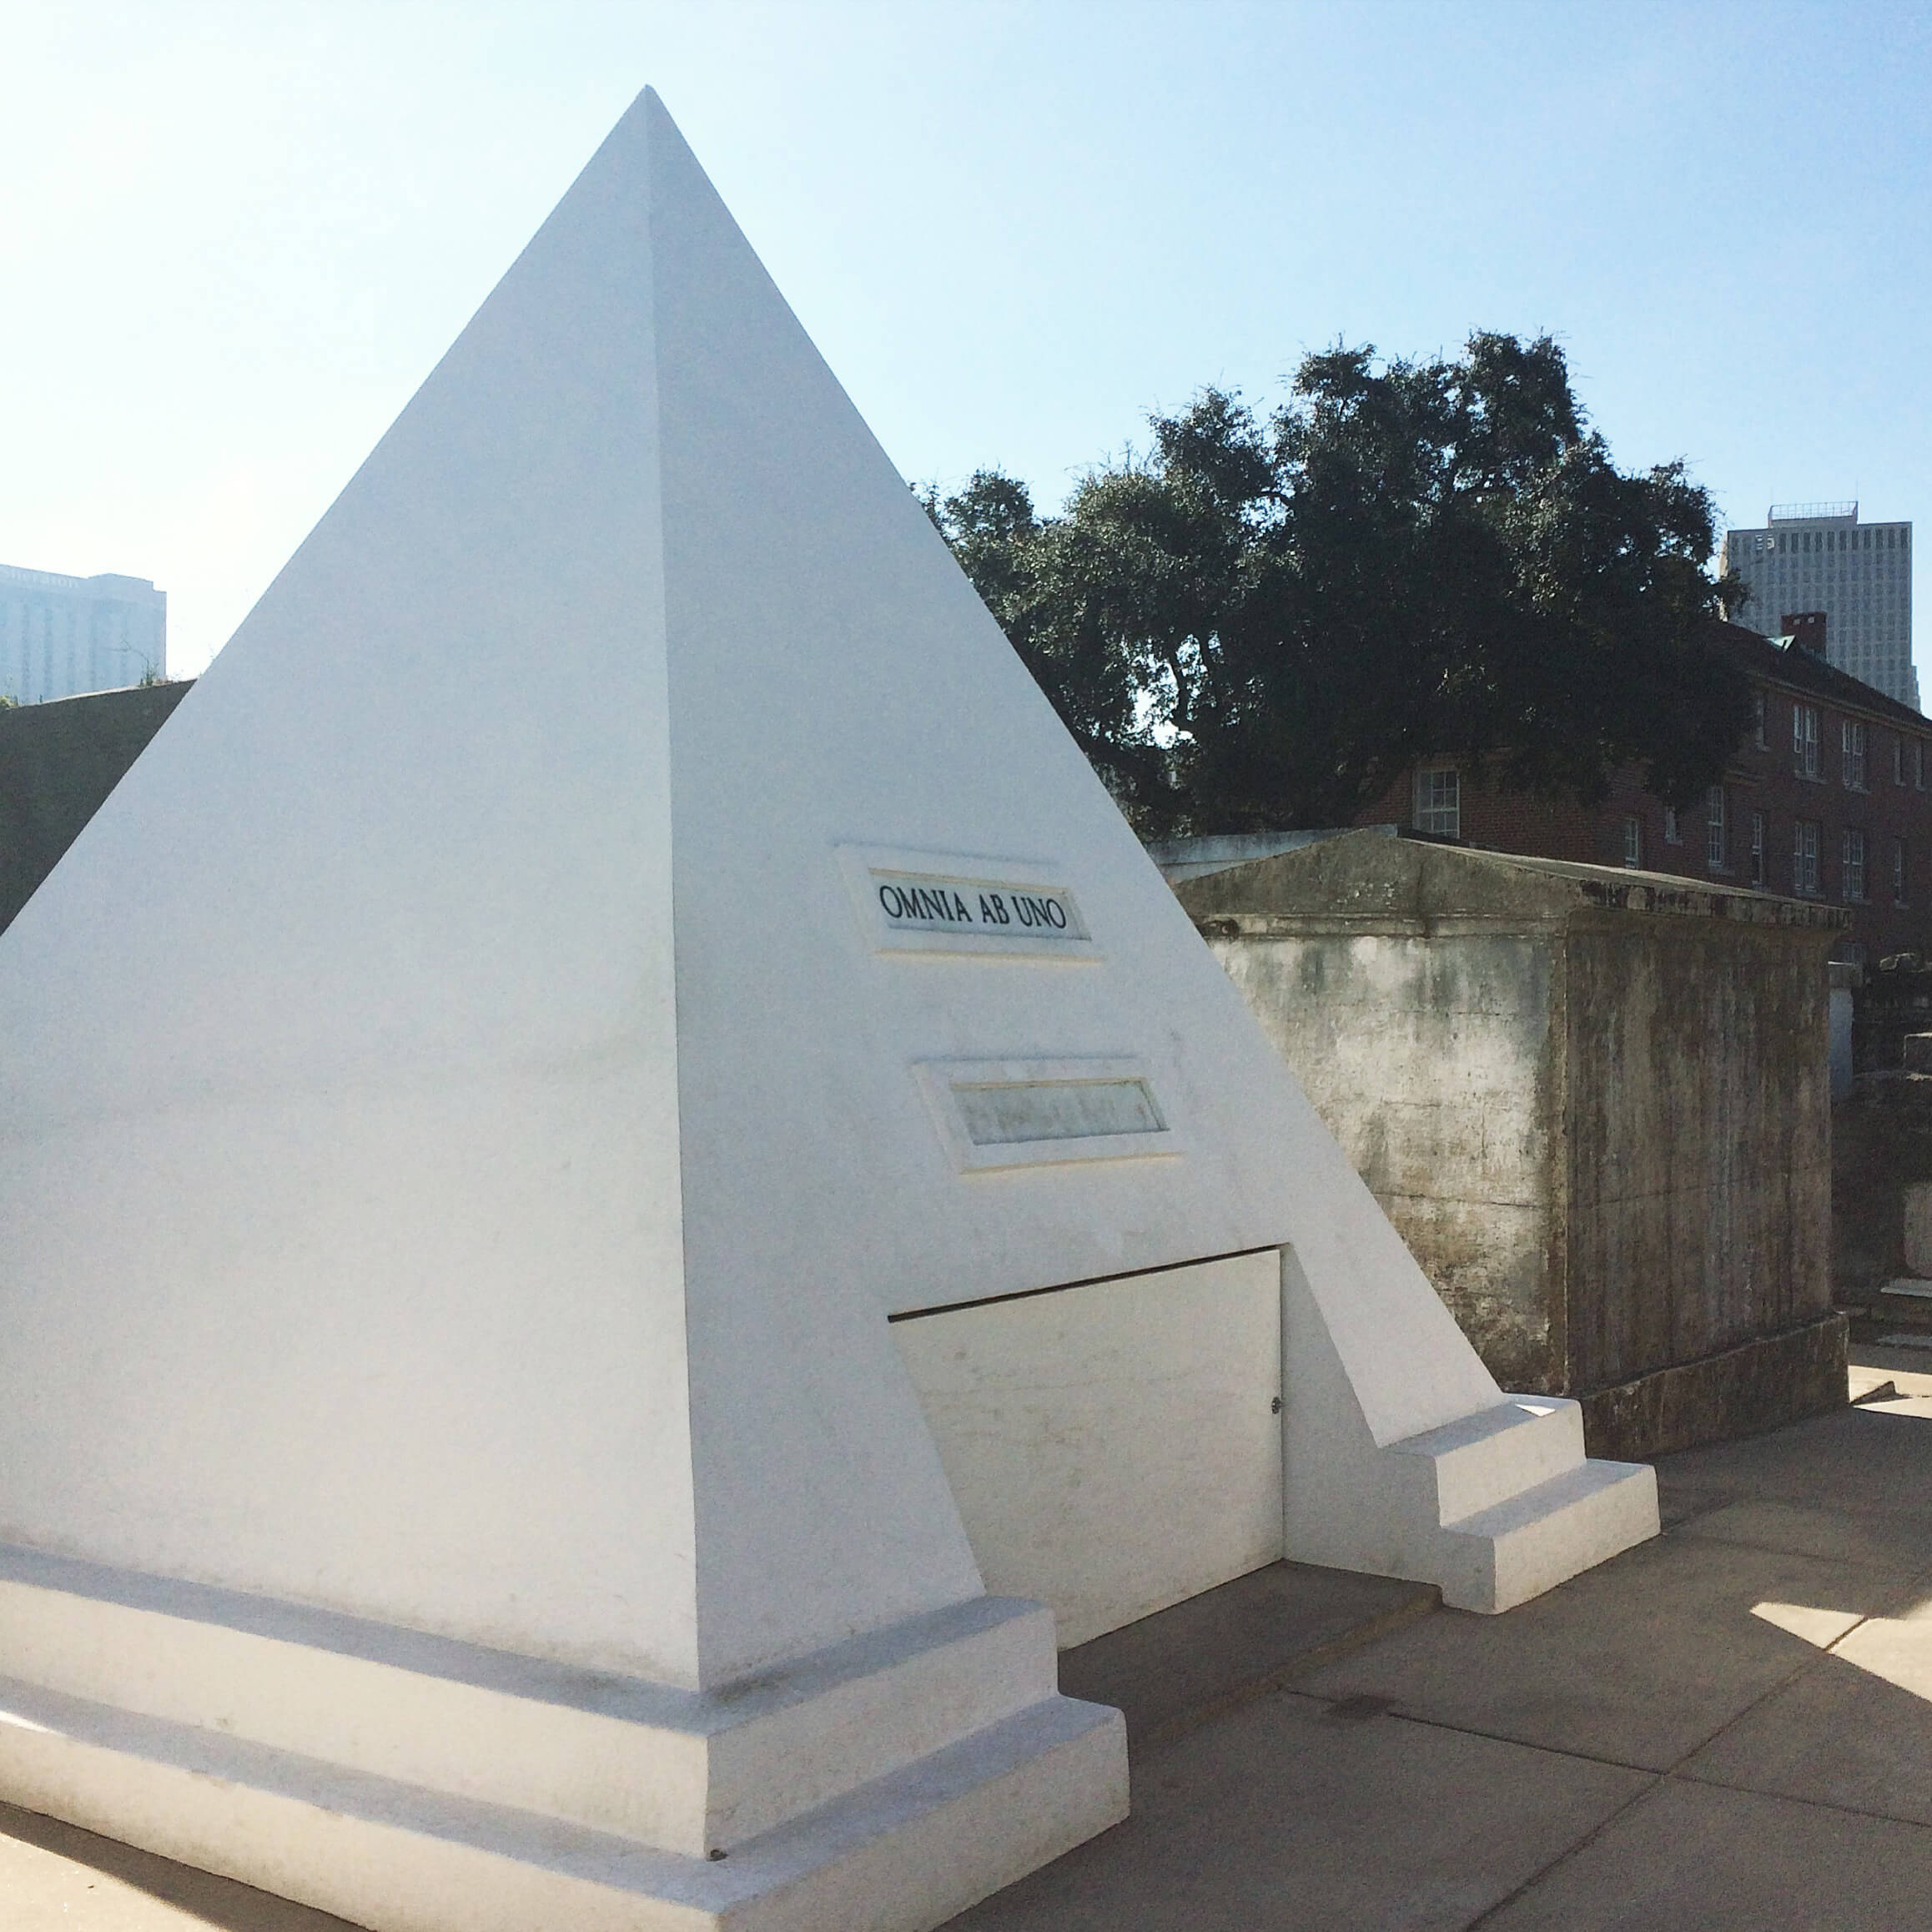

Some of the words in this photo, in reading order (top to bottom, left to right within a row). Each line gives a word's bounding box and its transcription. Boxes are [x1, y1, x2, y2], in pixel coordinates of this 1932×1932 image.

[879, 885, 973, 922] OMNIA
[979, 893, 1009, 924] AB
[1011, 896, 1067, 929] UNO
